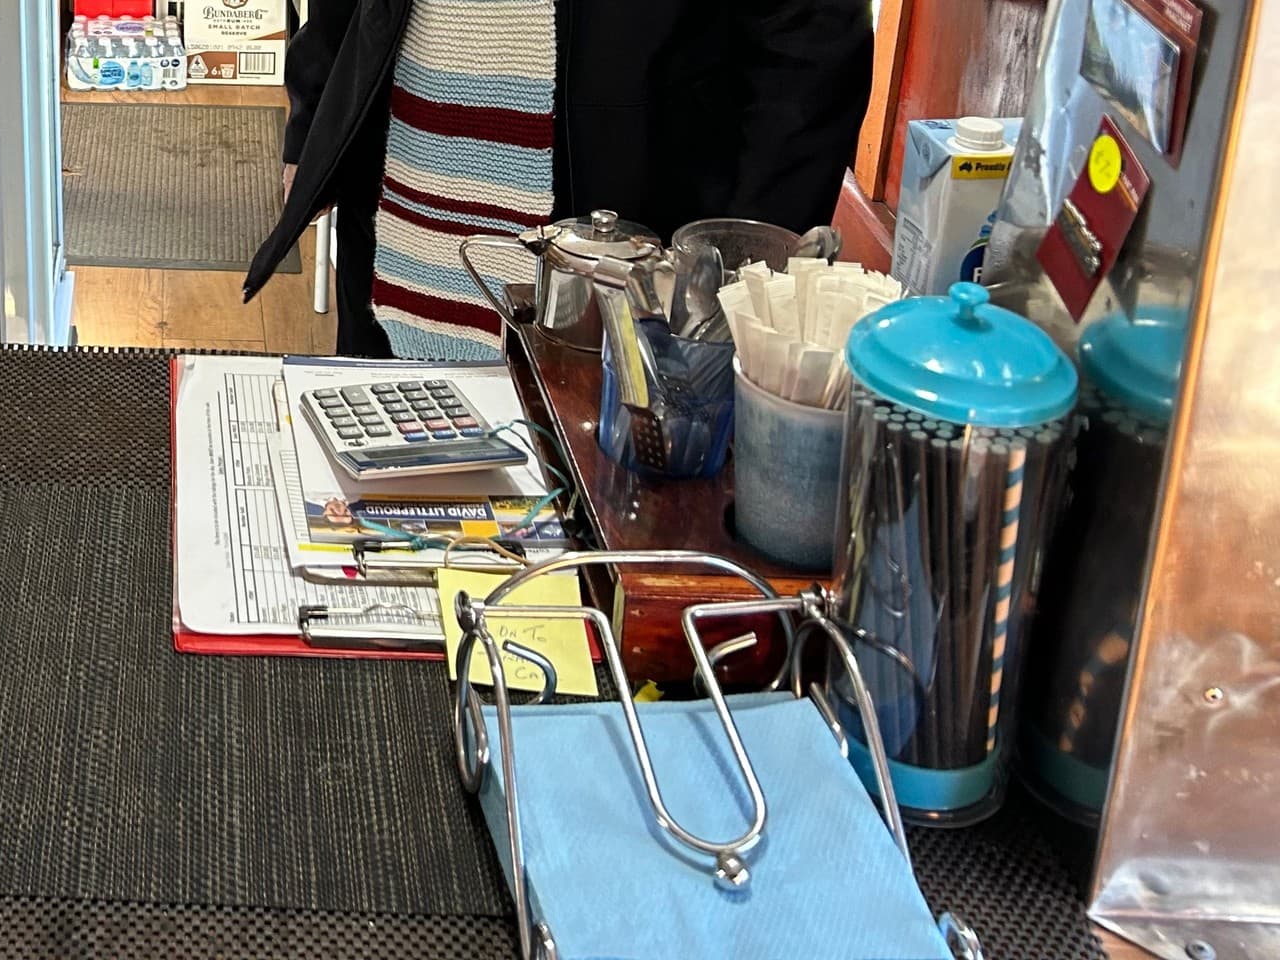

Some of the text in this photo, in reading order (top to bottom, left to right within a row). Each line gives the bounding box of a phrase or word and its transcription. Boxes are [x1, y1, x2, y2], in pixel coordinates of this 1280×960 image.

[202, 5, 263, 20] BUNDABERG
[365, 506, 446, 518] LITTLEPROUD
[446, 505, 488, 519] DAVID
